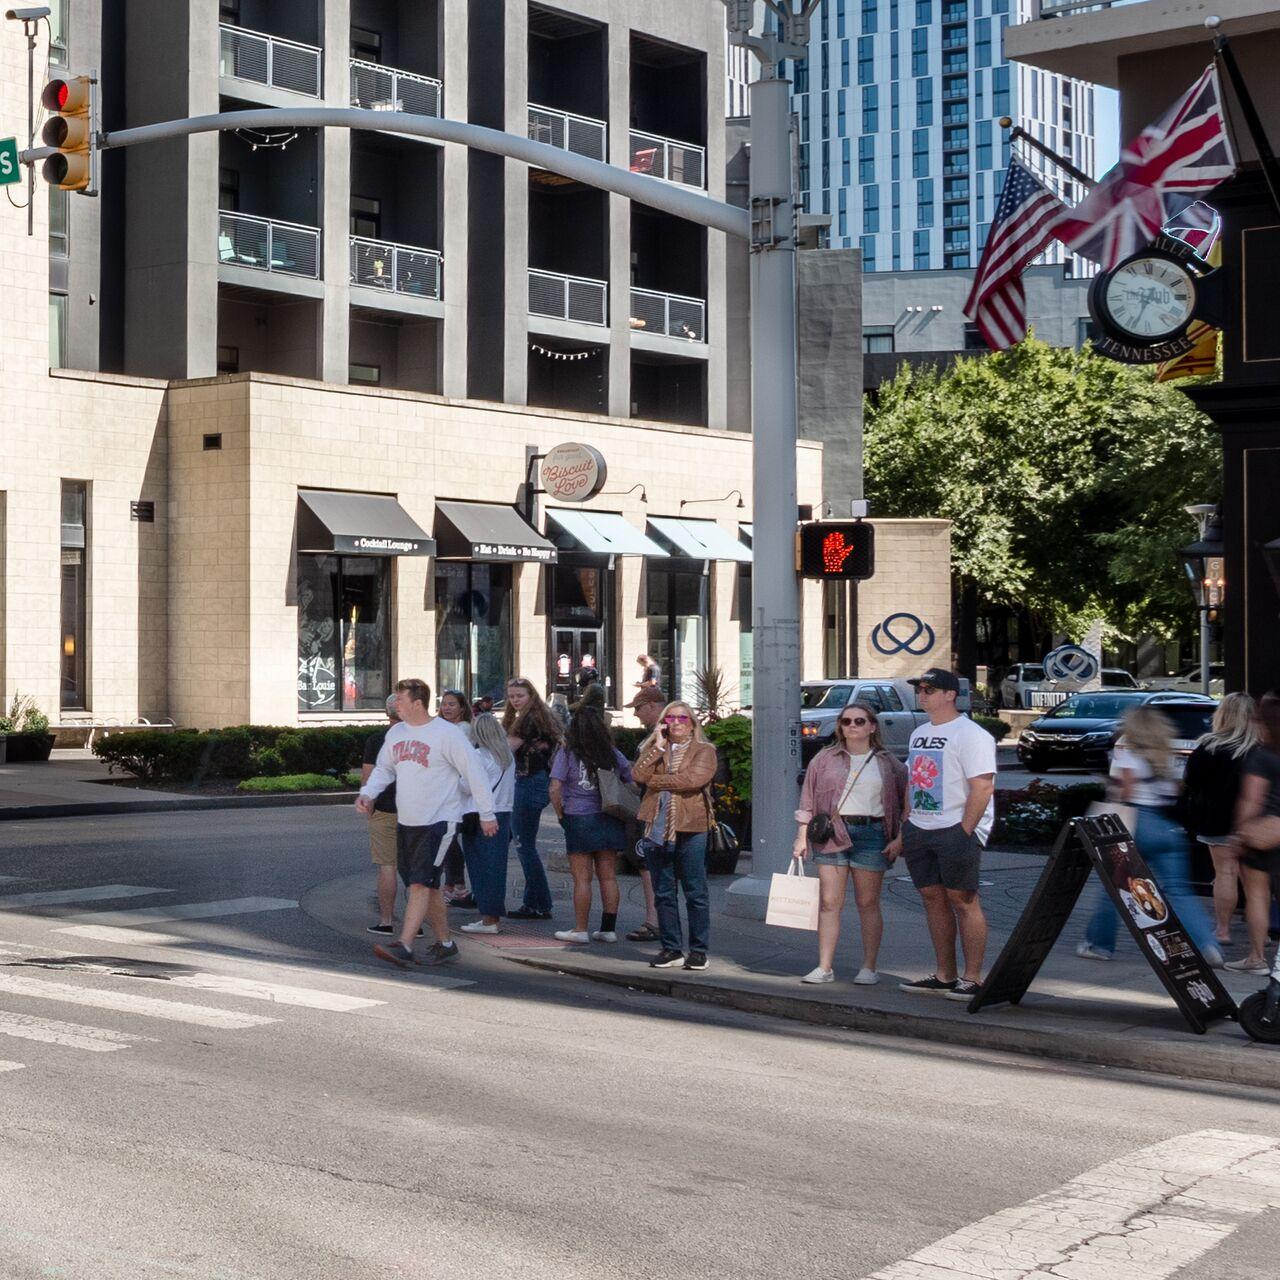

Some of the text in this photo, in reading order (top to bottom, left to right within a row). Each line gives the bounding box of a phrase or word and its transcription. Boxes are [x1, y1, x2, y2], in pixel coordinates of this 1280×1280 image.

[0, 151, 13, 175] S
[1101, 336, 1191, 361] TENNESSEE
[543, 459, 593, 481] Biscuit
[553, 474, 588, 496] Love
[360, 538, 413, 551] Cocktail Lounge
[480, 545, 492, 554] Eat
[497, 546, 517, 556] Drink
[532, 547, 551, 559] Happy
[312, 681, 336, 691] Louie
